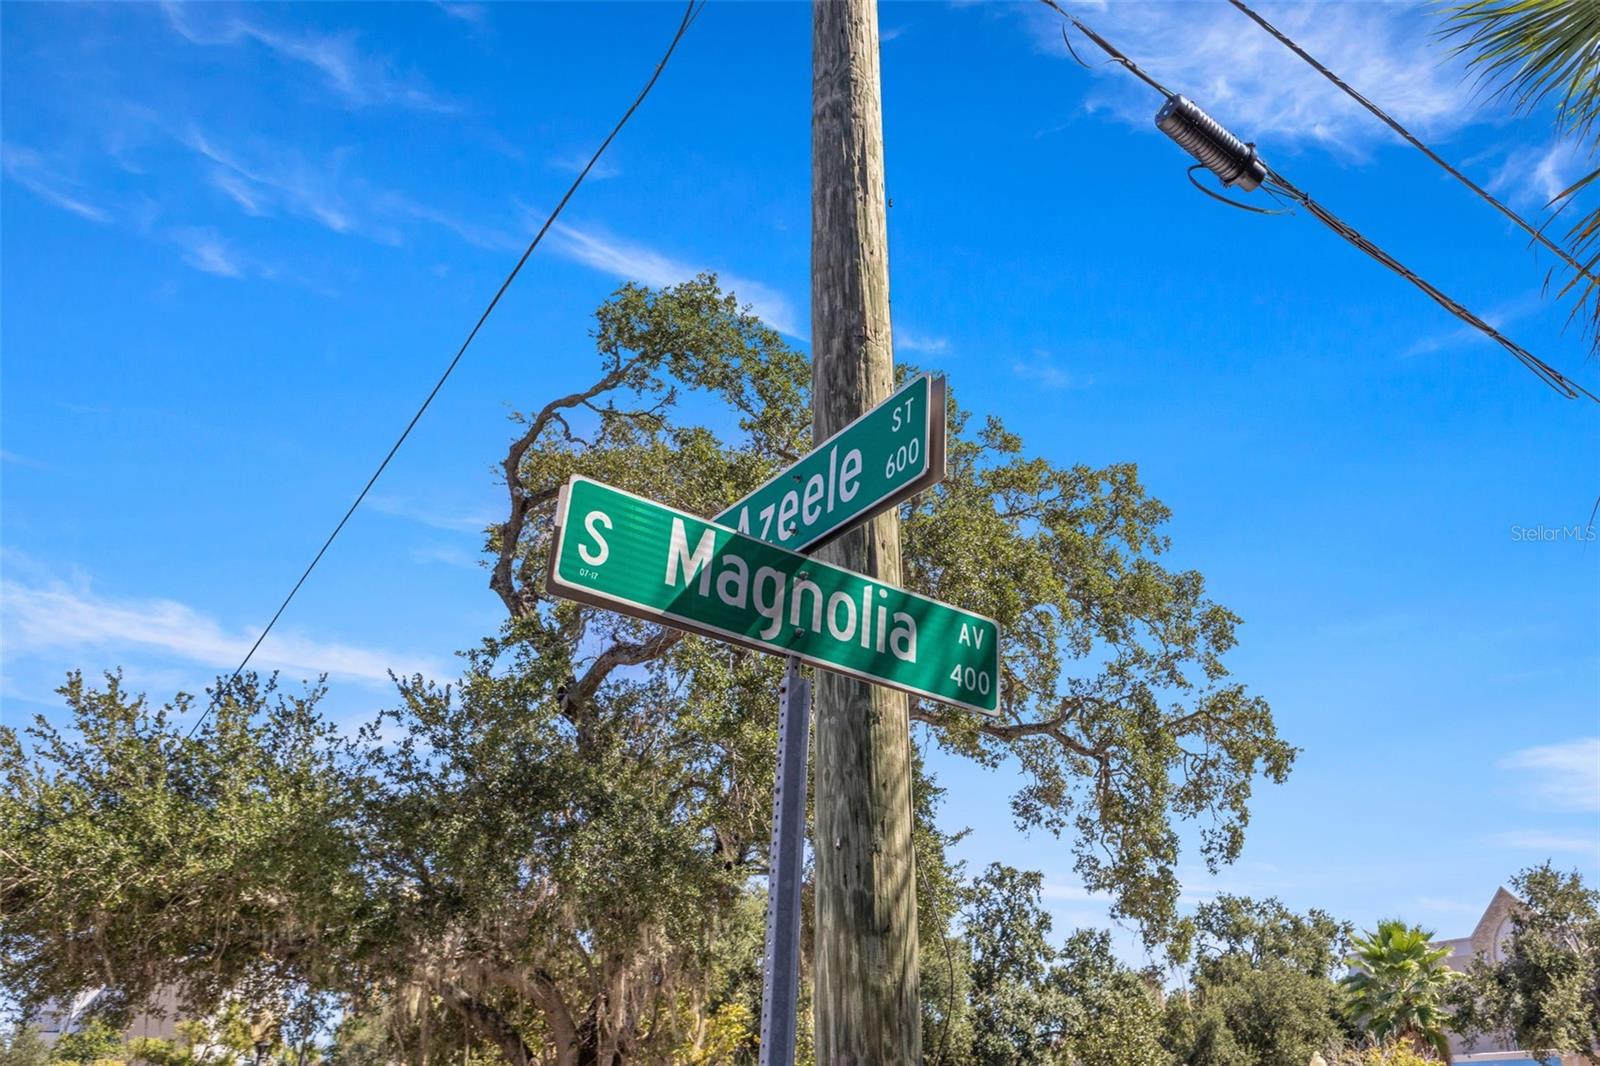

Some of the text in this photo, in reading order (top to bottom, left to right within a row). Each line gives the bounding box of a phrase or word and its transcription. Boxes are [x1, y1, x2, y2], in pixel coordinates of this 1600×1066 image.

[892, 397, 914, 432] ST
[886, 438, 919, 479] 600
[578, 510, 984, 664] S Magnolia AV
[950, 664, 990, 695] 400
